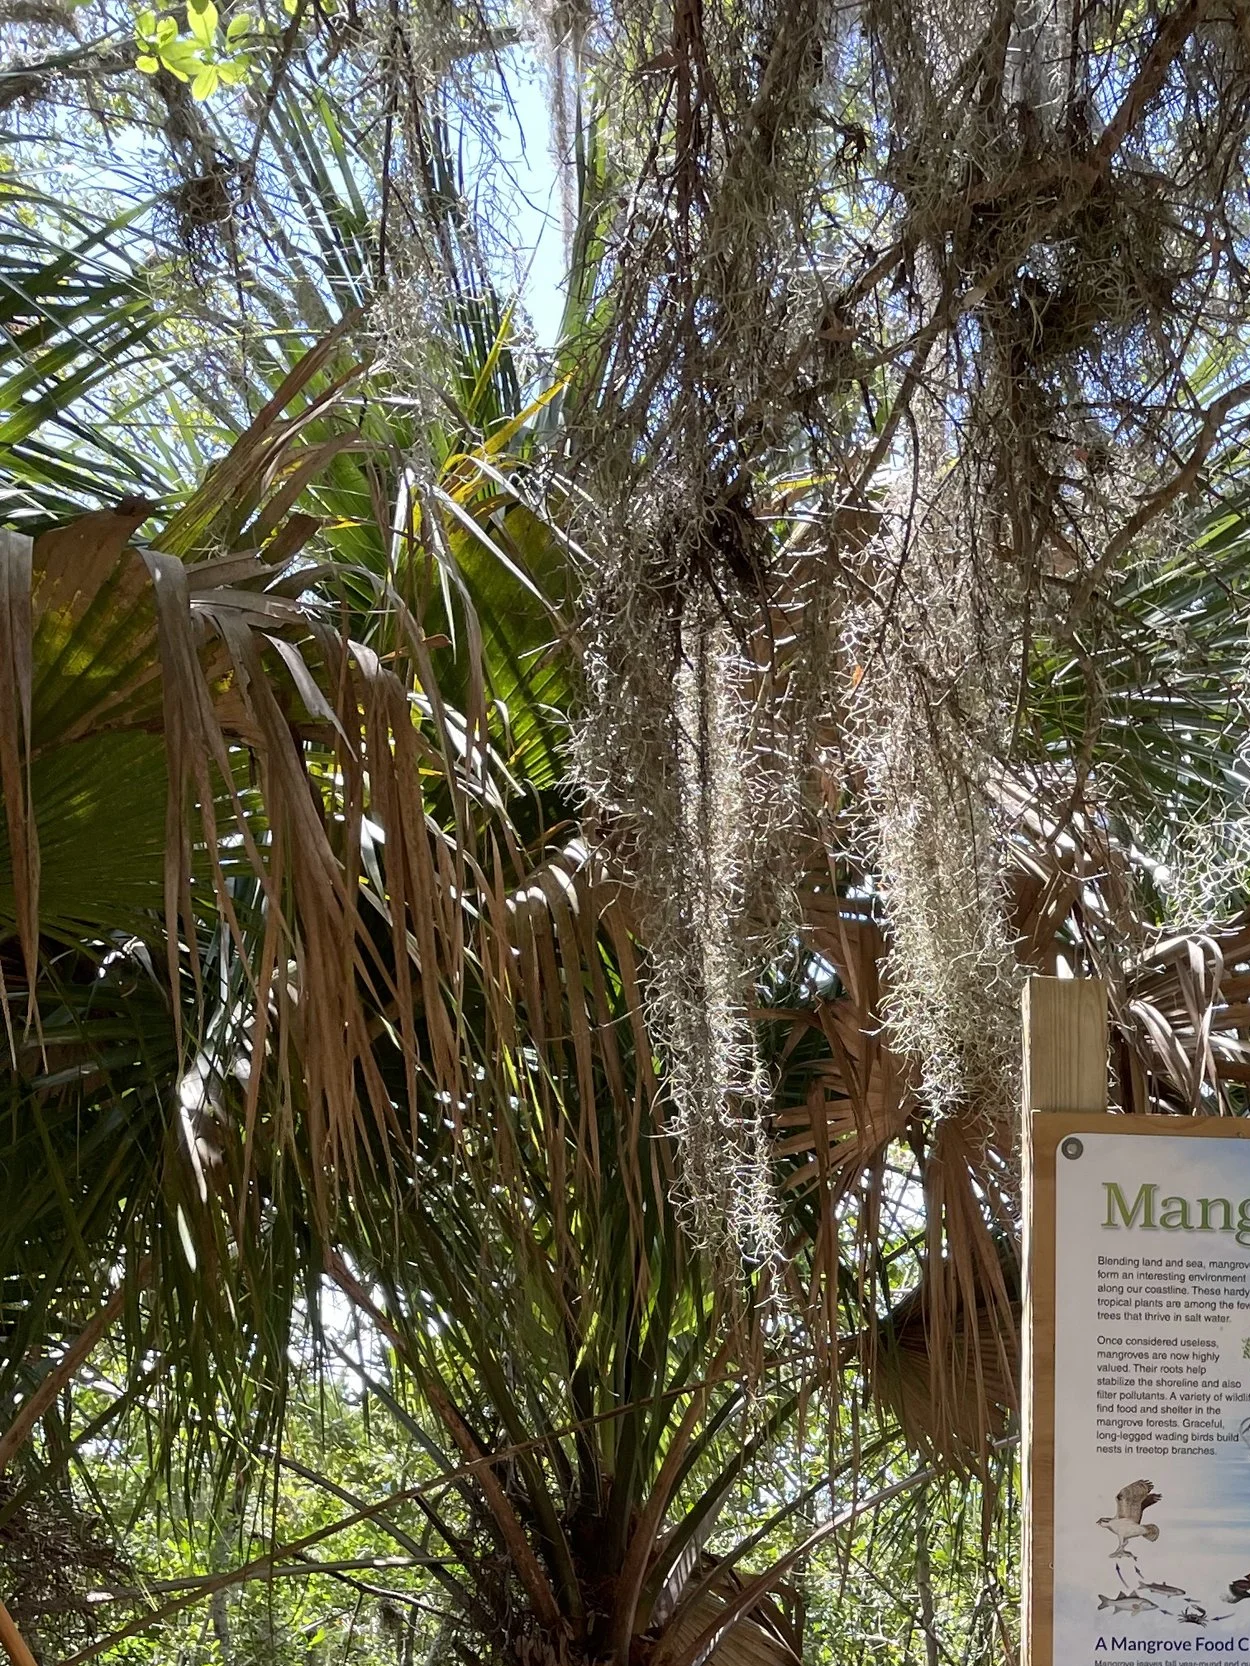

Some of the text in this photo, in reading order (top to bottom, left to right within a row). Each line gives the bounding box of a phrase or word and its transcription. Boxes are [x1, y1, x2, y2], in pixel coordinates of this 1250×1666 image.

[1098, 1256, 1139, 1268] Blending
[1142, 1257, 1162, 1267] land
[1166, 1258, 1183, 1267] and
[1098, 1270, 1119, 1279] form
[1137, 1271, 1185, 1283] interesting
[1189, 1273, 1246, 1282] environment
[1098, 1284, 1124, 1294] along
[1145, 1285, 1189, 1295] coastline.
[1192, 1286, 1221, 1295] These
[1224, 1287, 1250, 1298] hardy
[1098, 1298, 1131, 1308] tropical
[1135, 1299, 1163, 1308] plants
[1184, 1302, 1216, 1311] among
[1219, 1300, 1234, 1309] the
[1124, 1312, 1142, 1320] that
[1145, 1312, 1170, 1321] thrive
[1174, 1313, 1181, 1321] in
[1185, 1313, 1201, 1322] salt
[1097, 1336, 1219, 1348] Once considered useless,
[1097, 1351, 1149, 1360] mangroves
[1192, 1352, 1219, 1363] highly
[1097, 1364, 1130, 1372] valued.
[1133, 1364, 1157, 1373] Their
[1186, 1365, 1206, 1375] help
[1097, 1378, 1241, 1388] stabilize the shoreline and also
[1097, 1391, 1117, 1399] filter
[1120, 1392, 1168, 1400] pollutants.
[1180, 1393, 1210, 1403] variety
[1214, 1393, 1222, 1401] of
[1097, 1404, 1113, 1413] find
[1117, 1405, 1137, 1413] food
[1161, 1406, 1192, 1414] shelter
[1195, 1406, 1203, 1414] in
[1207, 1406, 1220, 1414] the
[1097, 1419, 1224, 1429] mangrove forests. Graceful,
[1097, 1432, 1238, 1443] long-legged wading birds build
[1125, 1445, 1133, 1454] in
[1136, 1446, 1168, 1455] treetop
[1095, 1637, 1107, 1651] A
[1112, 1637, 1192, 1654] Mangrove
[1196, 1638, 1234, 1651] Food
